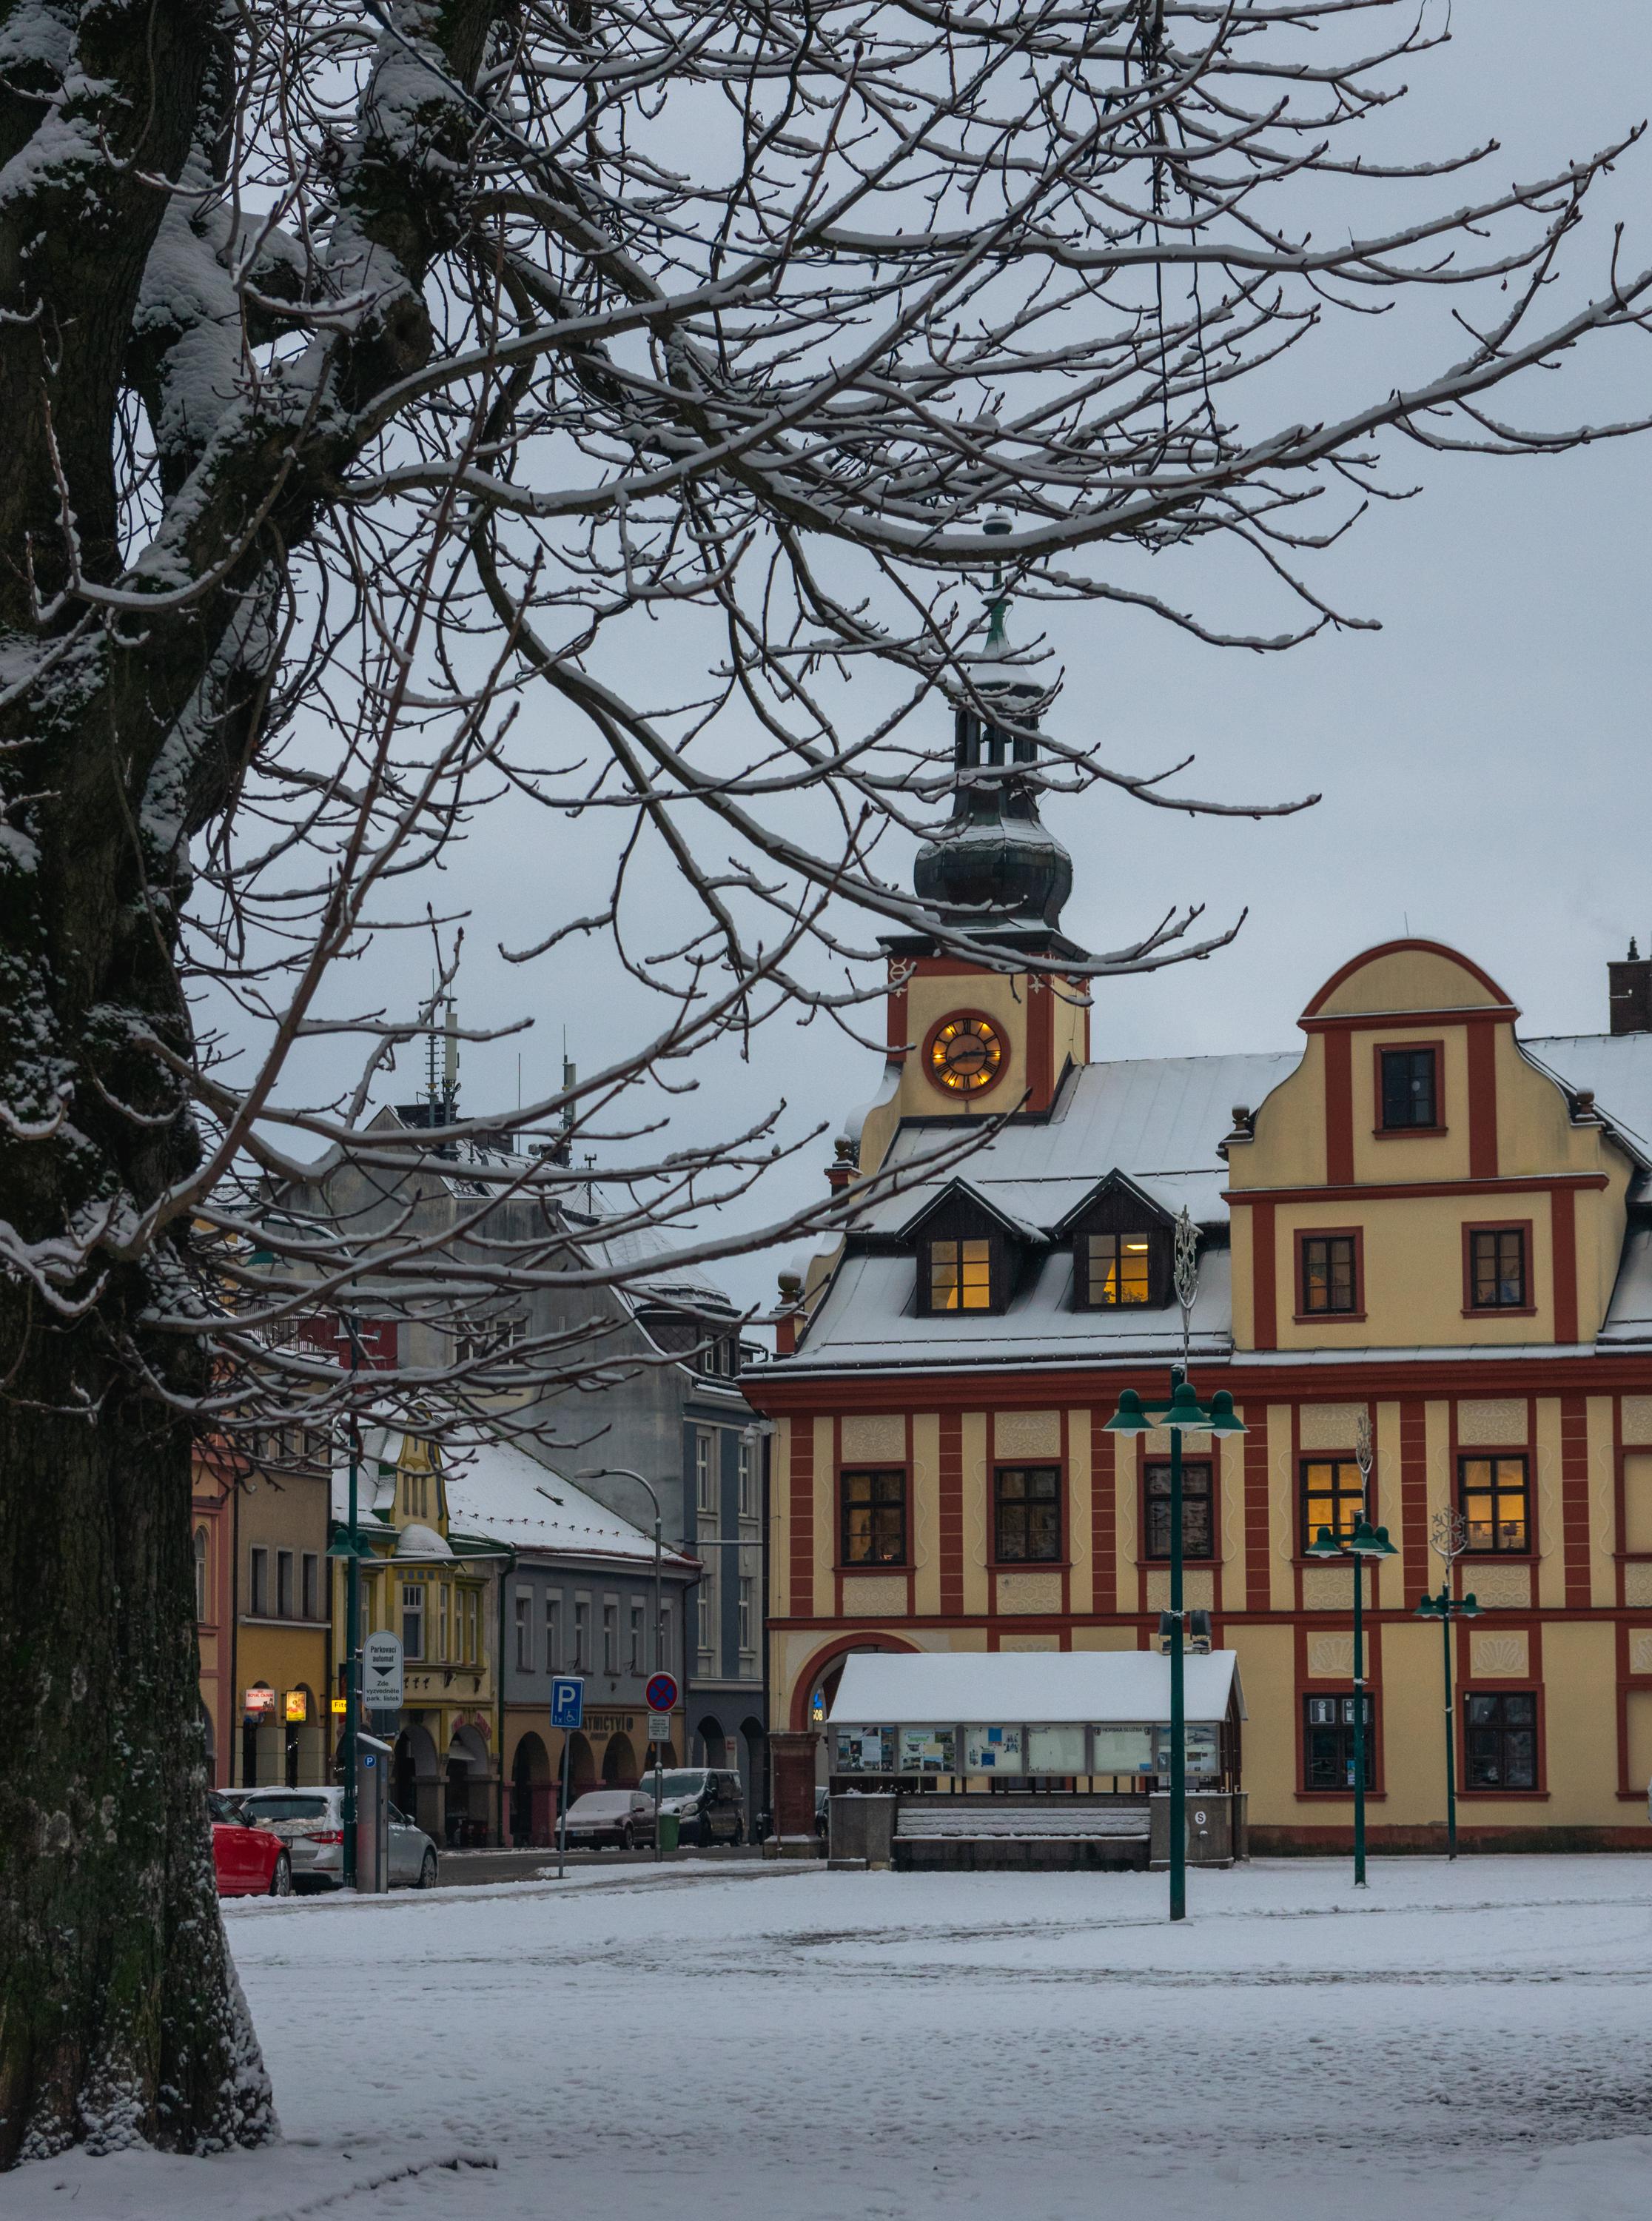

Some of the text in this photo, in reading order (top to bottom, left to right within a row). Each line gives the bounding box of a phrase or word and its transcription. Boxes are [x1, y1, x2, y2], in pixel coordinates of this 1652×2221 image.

[558, 1686, 576, 1712] P
[366, 1757, 373, 1766] P
[1198, 1813, 1203, 1822] S
